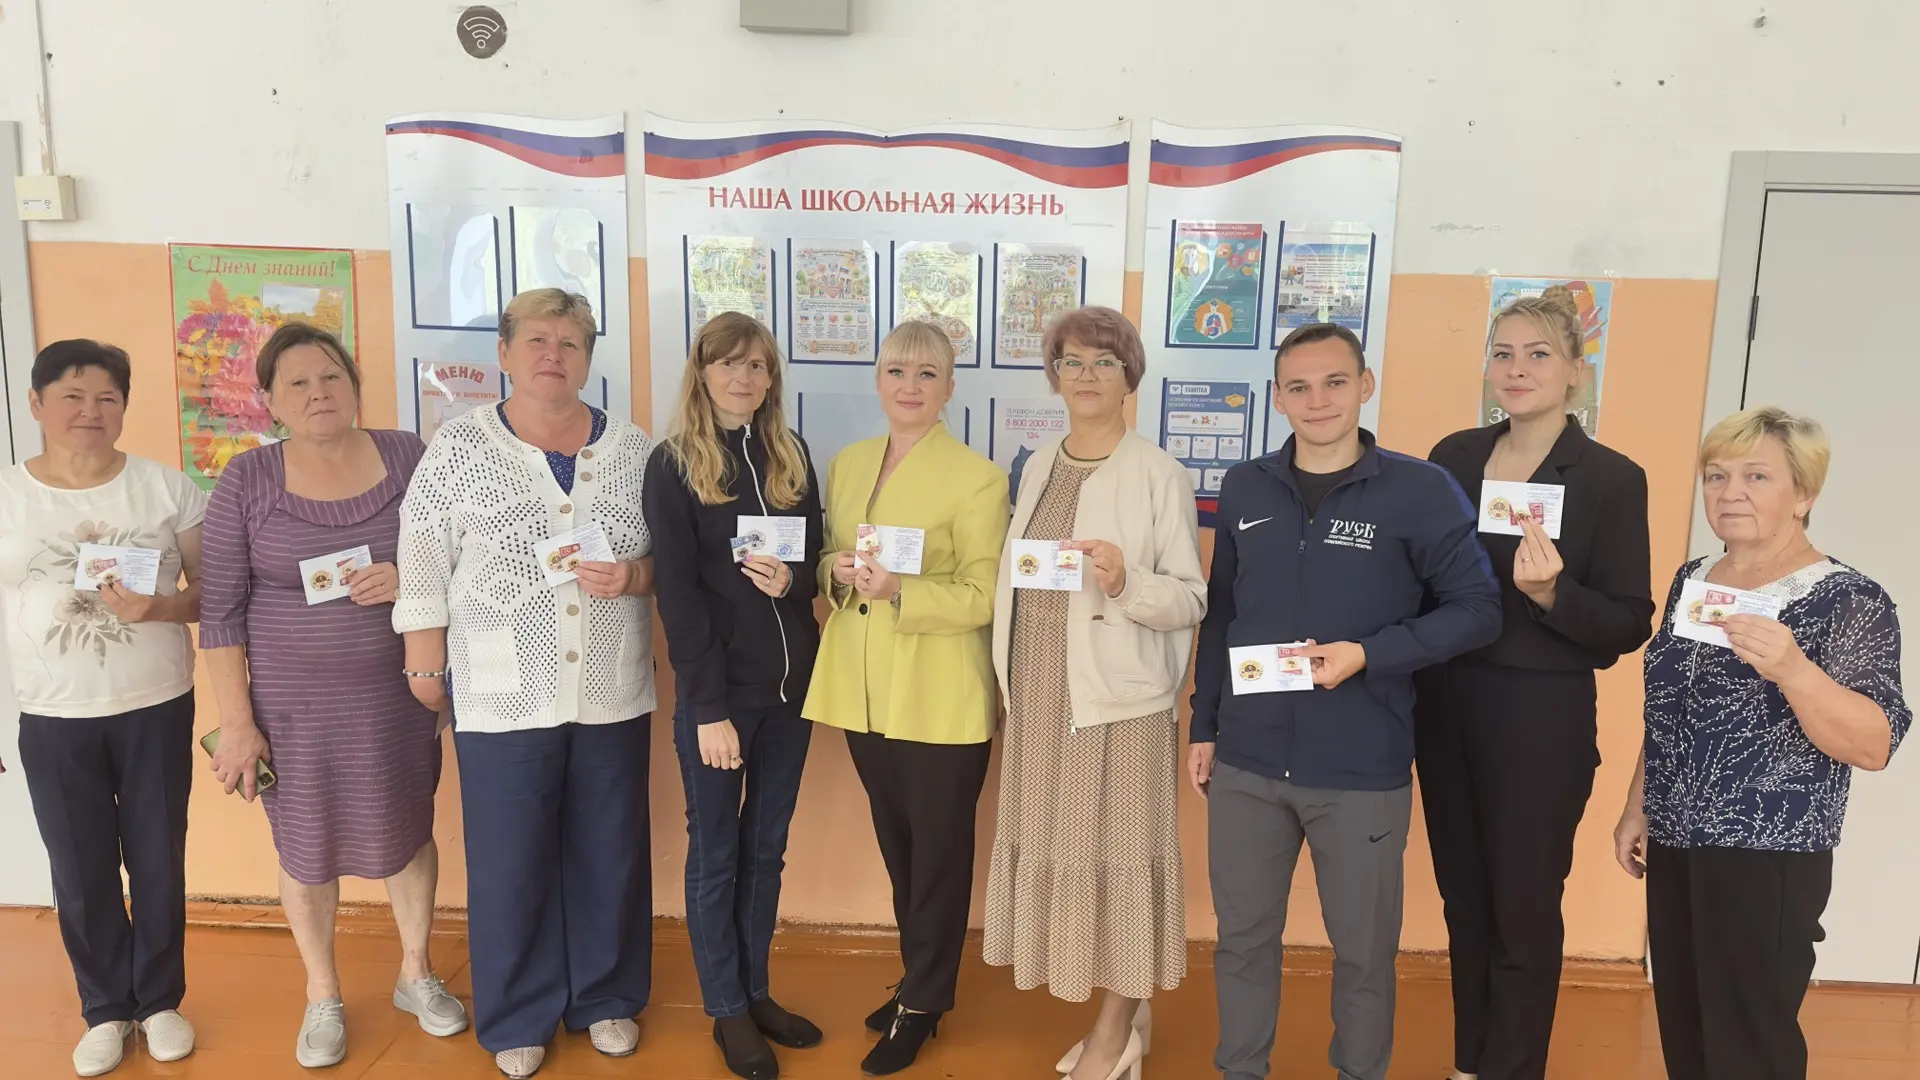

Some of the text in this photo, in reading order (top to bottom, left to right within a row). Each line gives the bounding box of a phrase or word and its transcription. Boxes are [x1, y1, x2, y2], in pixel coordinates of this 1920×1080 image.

[709, 187, 1064, 216] НАША ШКОЛЬНАЯ ЖИЗНЬ
[188, 255, 334, 277] С Днем знаний!
[435, 366, 485, 384] МЕНЮ
[1005, 419, 1065, 428] 8 800 2000 122
[1026, 431, 1040, 440] 124
